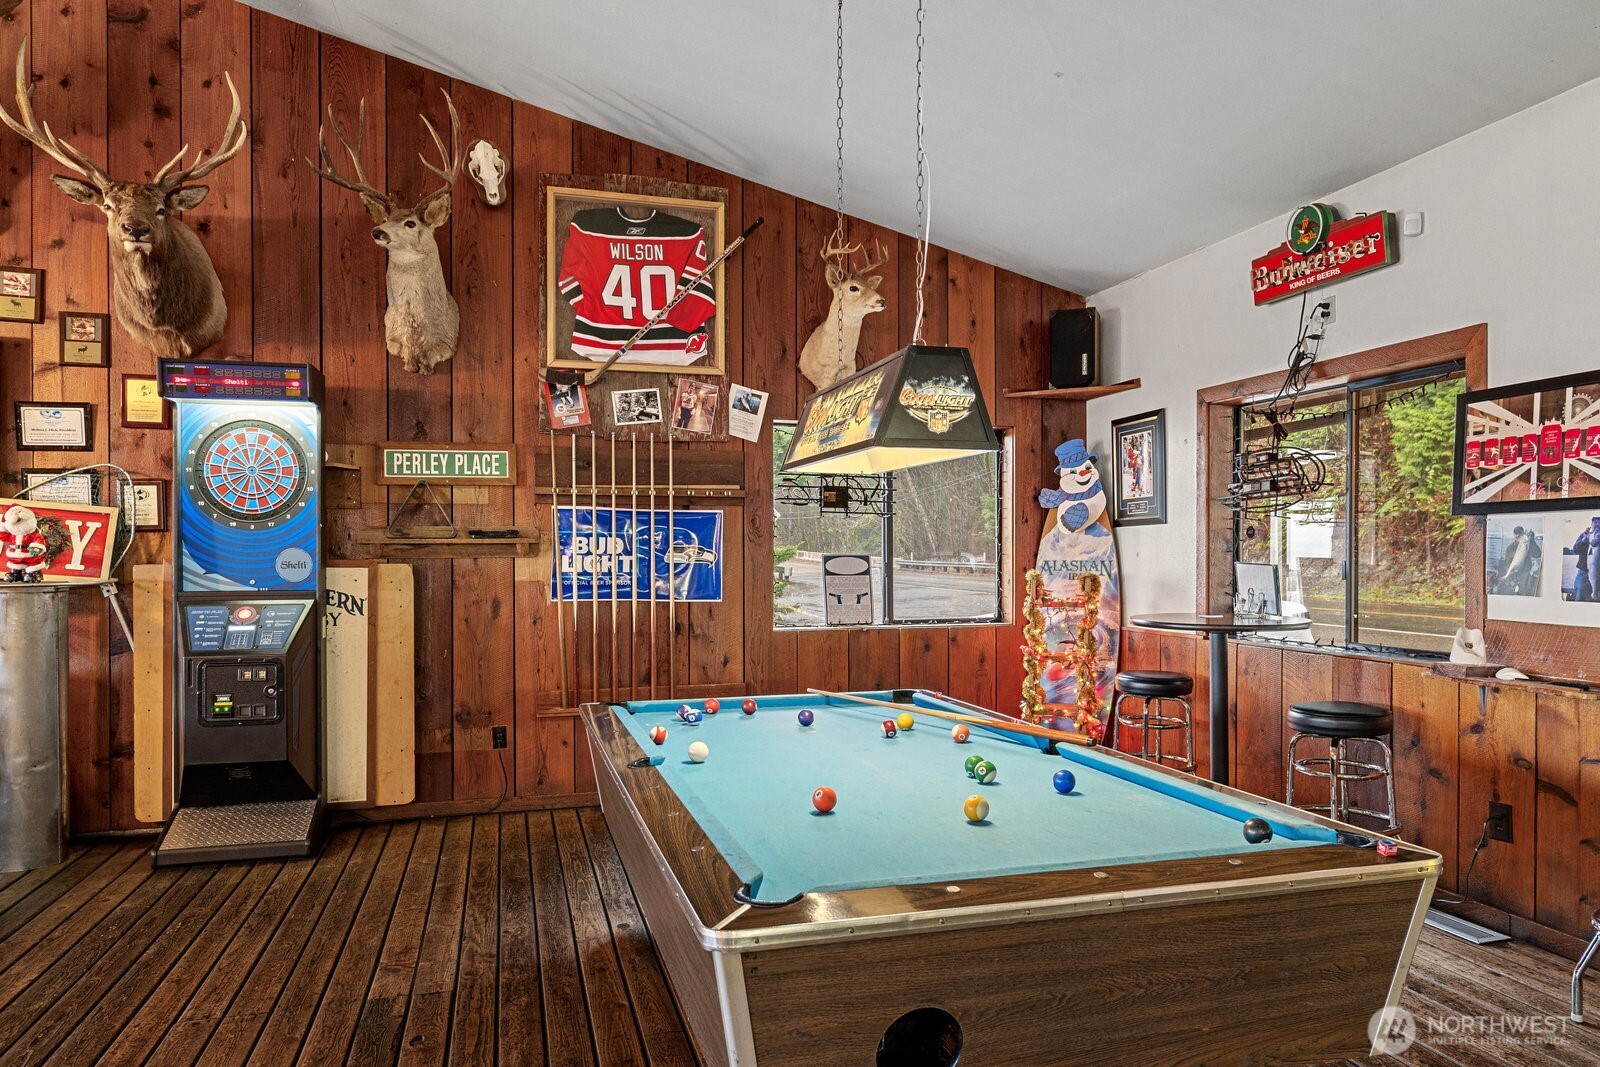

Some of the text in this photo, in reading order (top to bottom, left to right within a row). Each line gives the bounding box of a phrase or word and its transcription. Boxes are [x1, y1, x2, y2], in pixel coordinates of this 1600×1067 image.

[609, 242, 664, 261] WILSON
[1289, 267, 1341, 290] KING OF BEERS
[601, 263, 676, 321] 40
[900, 387, 974, 408] Coors LIGHT
[393, 452, 500, 476] PERLEY PLACE
[573, 536, 624, 554] BUD
[280, 560, 307, 570] Shelti
[561, 554, 633, 573] LIGHT
[1040, 560, 1113, 580] ALASKAN
